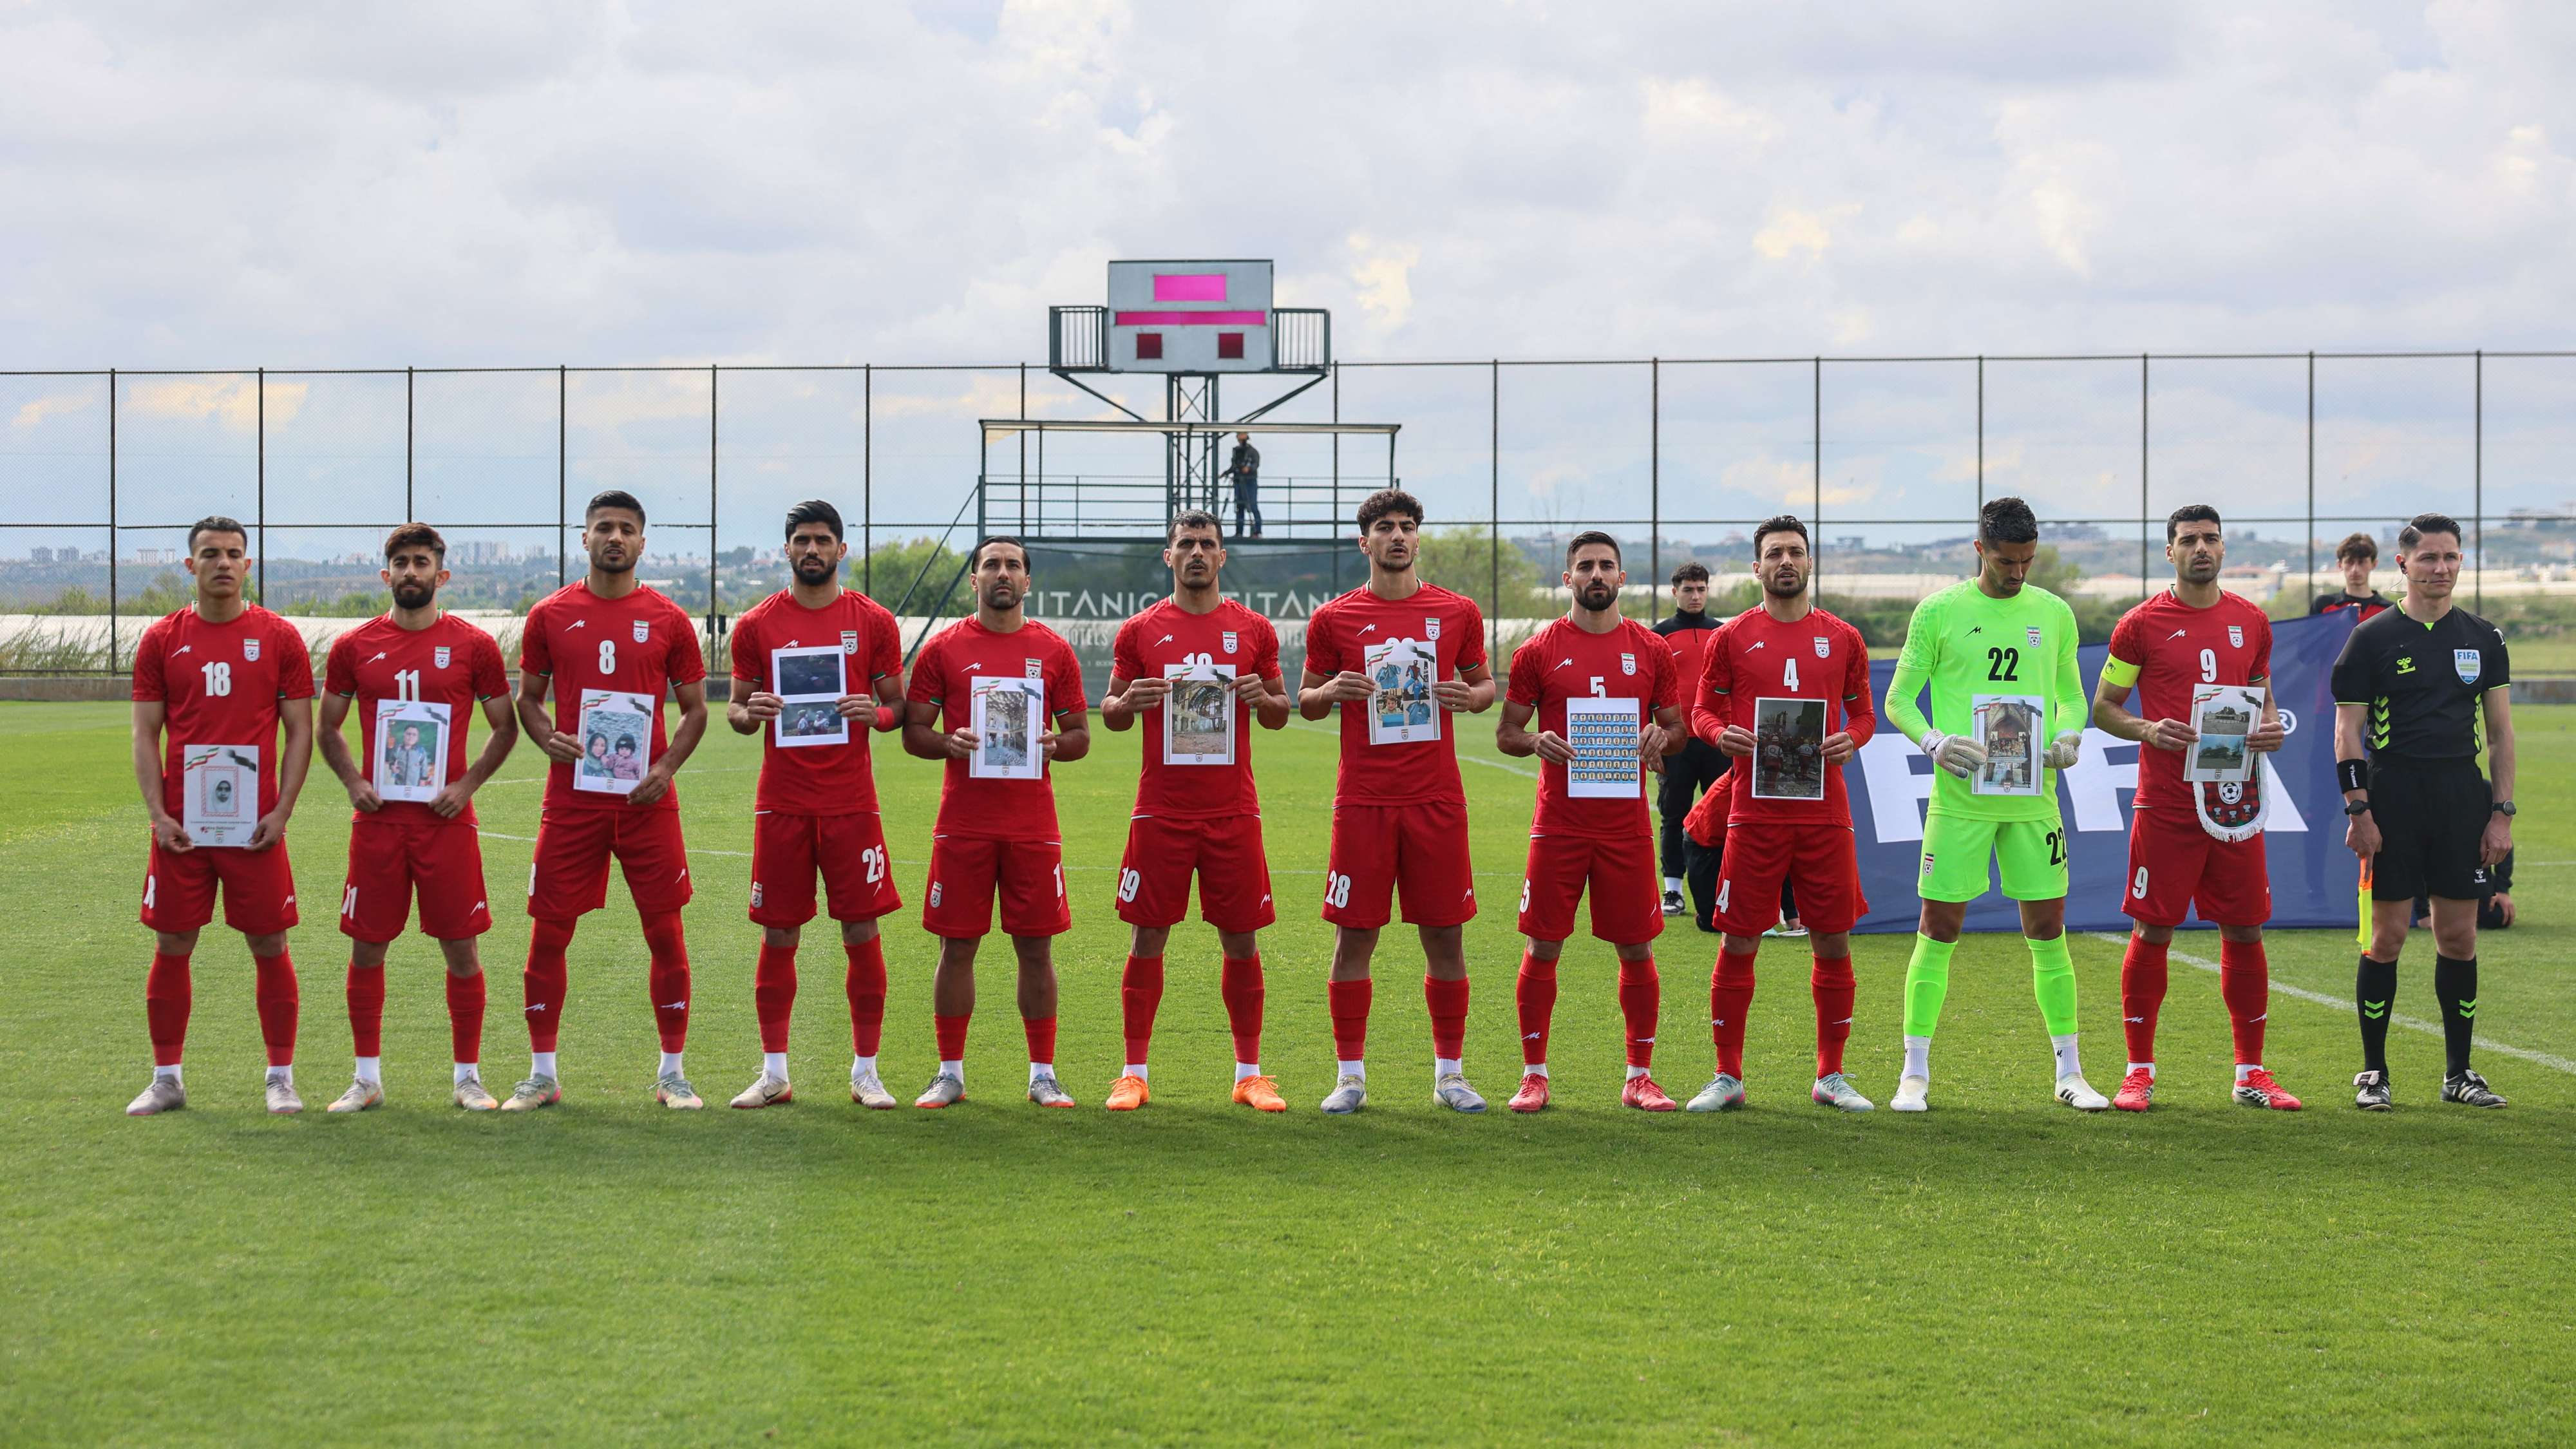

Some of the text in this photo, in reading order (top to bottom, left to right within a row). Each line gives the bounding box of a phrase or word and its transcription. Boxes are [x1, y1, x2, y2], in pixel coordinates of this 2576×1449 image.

[599, 639, 616, 675] 8
[1987, 647, 2019, 681] 22
[2199, 649, 2217, 683] 9
[2457, 651, 2478, 660] FIFA
[201, 661, 231, 696] 18
[393, 669, 420, 701] 11
[1590, 676, 1605, 699] 5
[1783, 658, 1799, 692] 4
[1856, 728, 2309, 843] FF
[862, 844, 885, 884] 25
[1119, 866, 1140, 902] 19
[1325, 870, 1351, 908] 28
[1716, 879, 1730, 914] 4
[2132, 866, 2148, 900] 9
